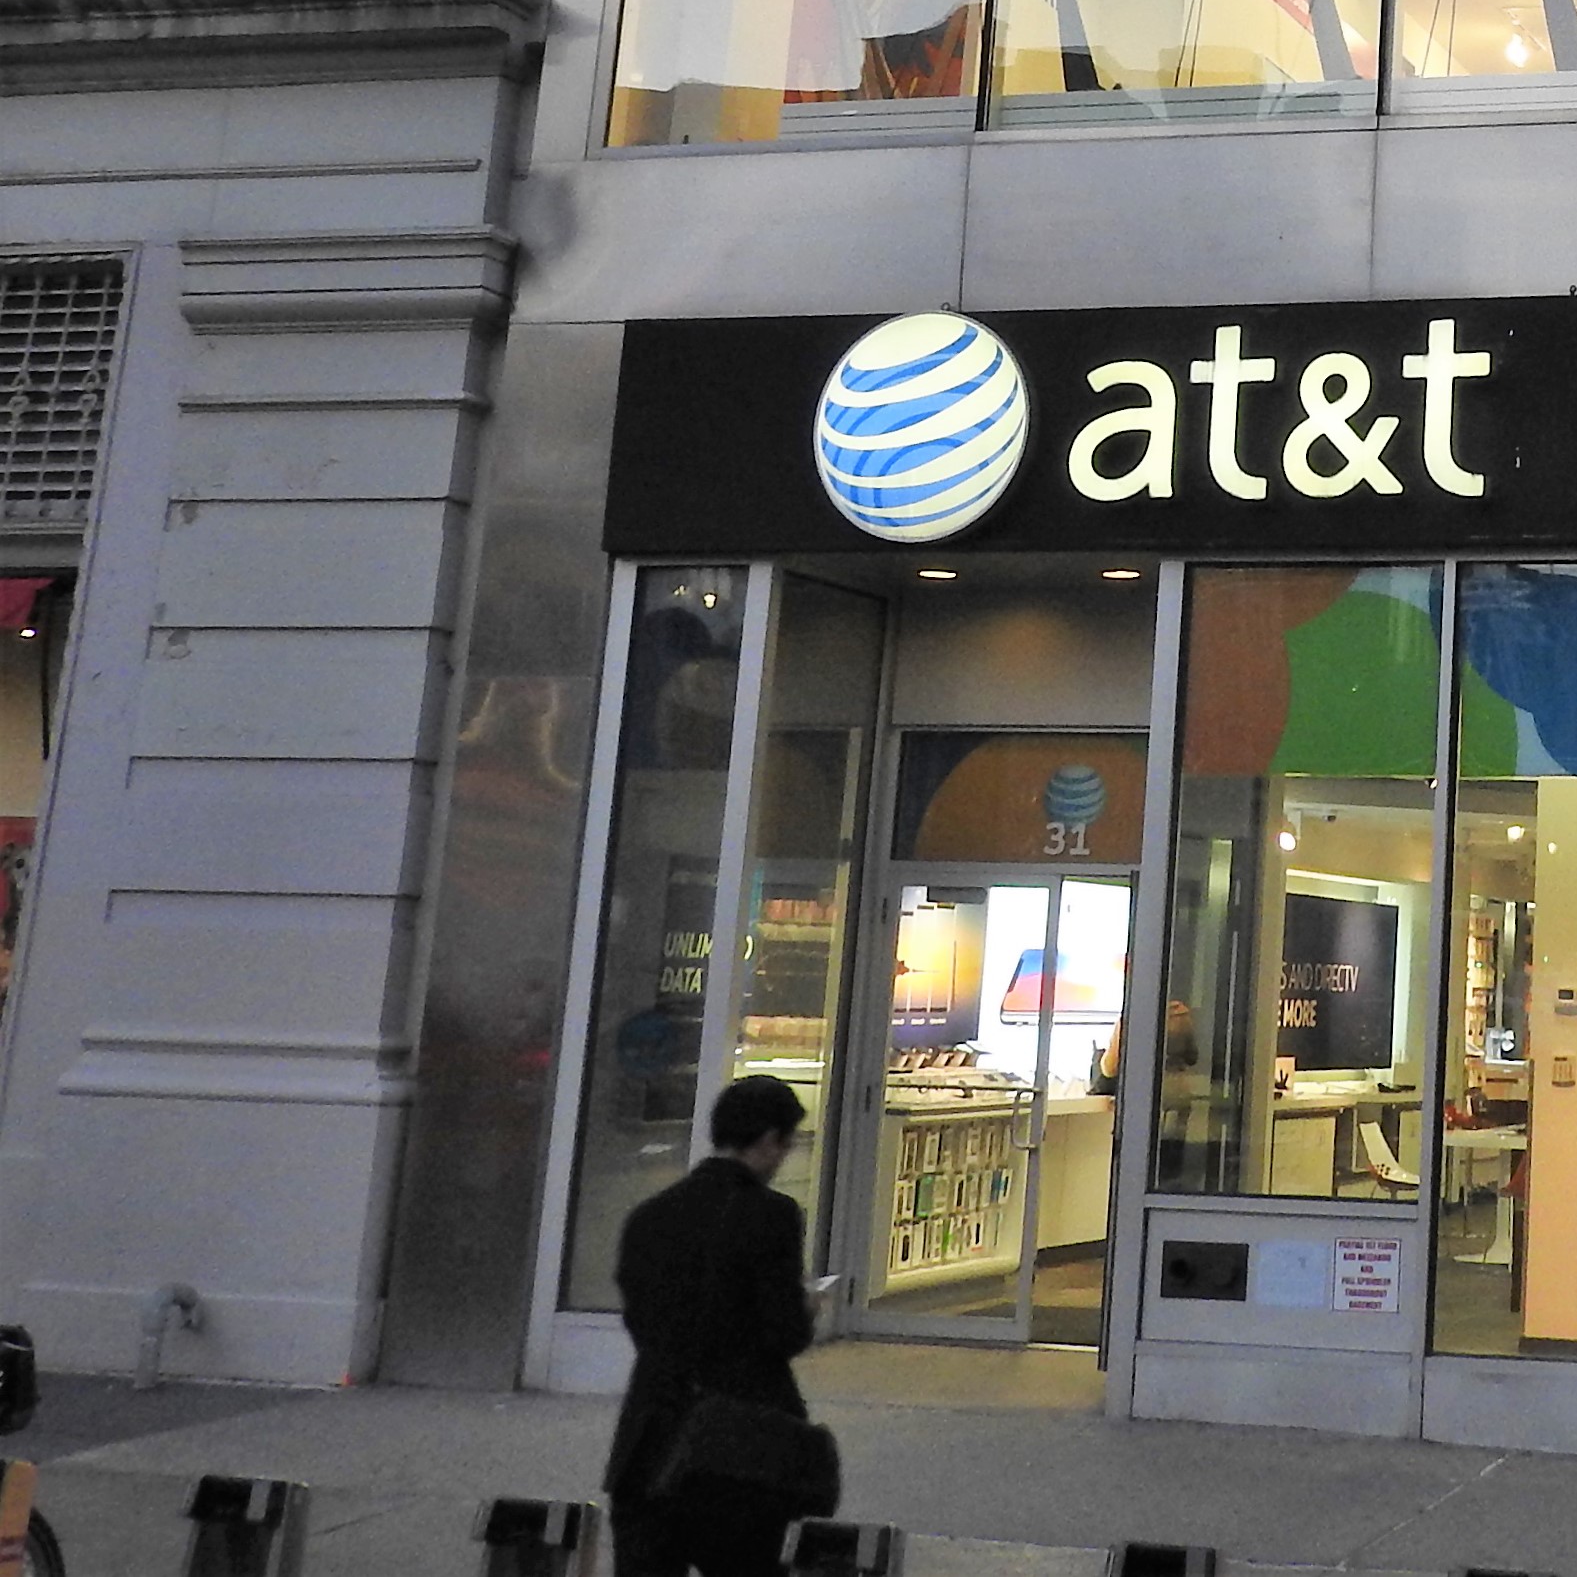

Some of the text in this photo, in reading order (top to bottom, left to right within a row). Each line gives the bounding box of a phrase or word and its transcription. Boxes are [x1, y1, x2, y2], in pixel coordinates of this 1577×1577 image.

[1066, 318, 1490, 501] at&t
[1043, 822, 1091, 857] 31
[664, 932, 713, 959] UNLIM
[660, 965, 703, 994] DATA
[1315, 963, 1359, 993] DRECTV
[1283, 998, 1318, 1029] MORE
